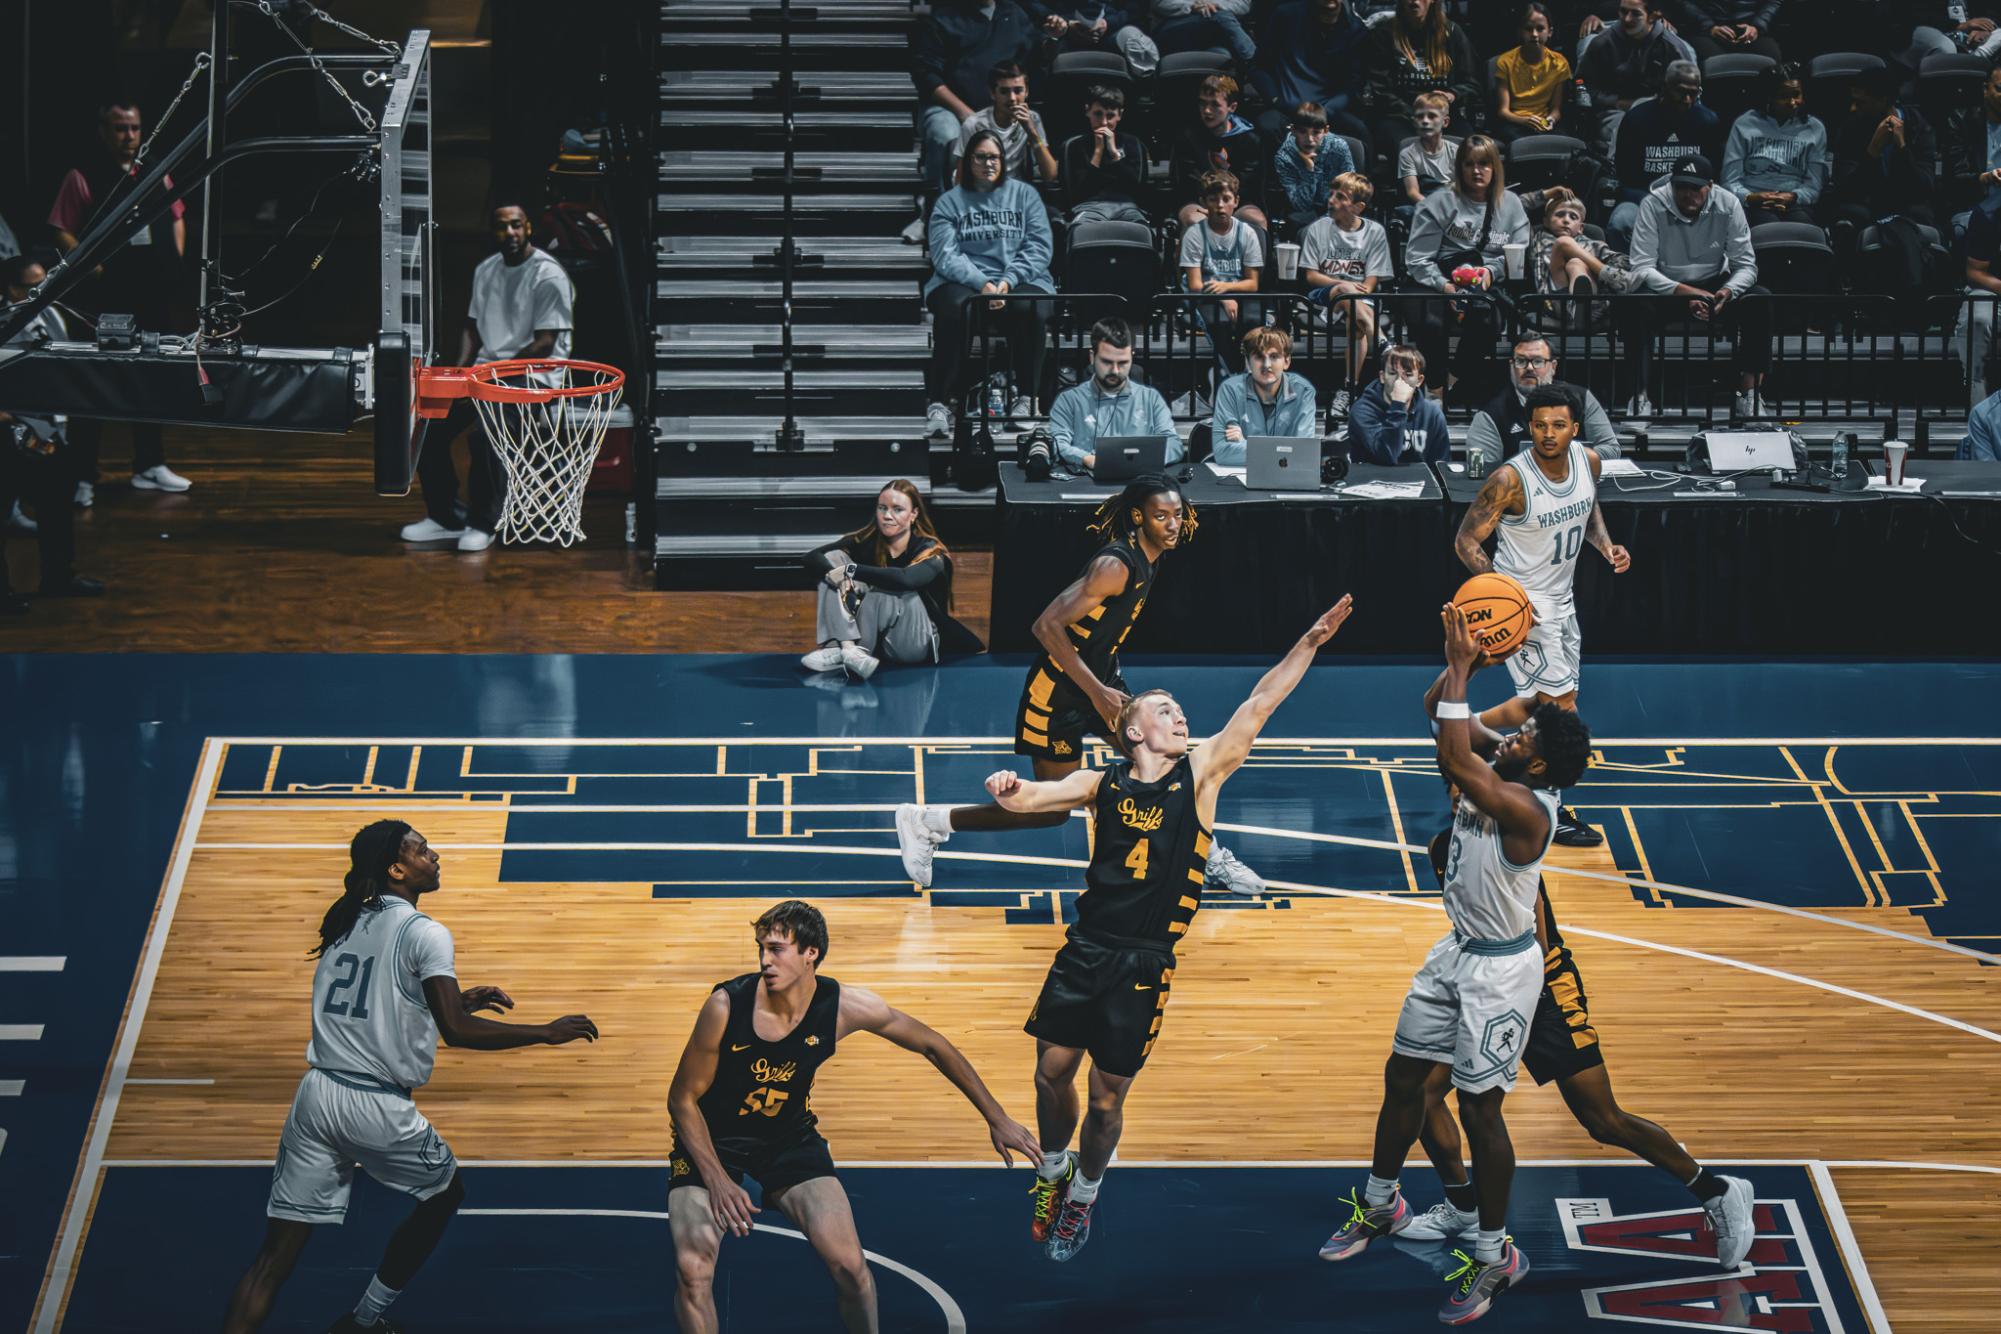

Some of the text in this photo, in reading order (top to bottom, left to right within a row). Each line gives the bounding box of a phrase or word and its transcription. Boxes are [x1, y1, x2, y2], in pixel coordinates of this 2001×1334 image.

[1645, 145, 1701, 158] WASHBURN
[1644, 161, 1675, 173] BASKE
[1745, 445, 1756, 455] hp
[1537, 497, 1592, 528] WASHBURN
[1551, 525, 1582, 566] 10
[1125, 838, 1149, 880] 4
[322, 952, 375, 1019] 21
[738, 1087, 789, 1117] 55
